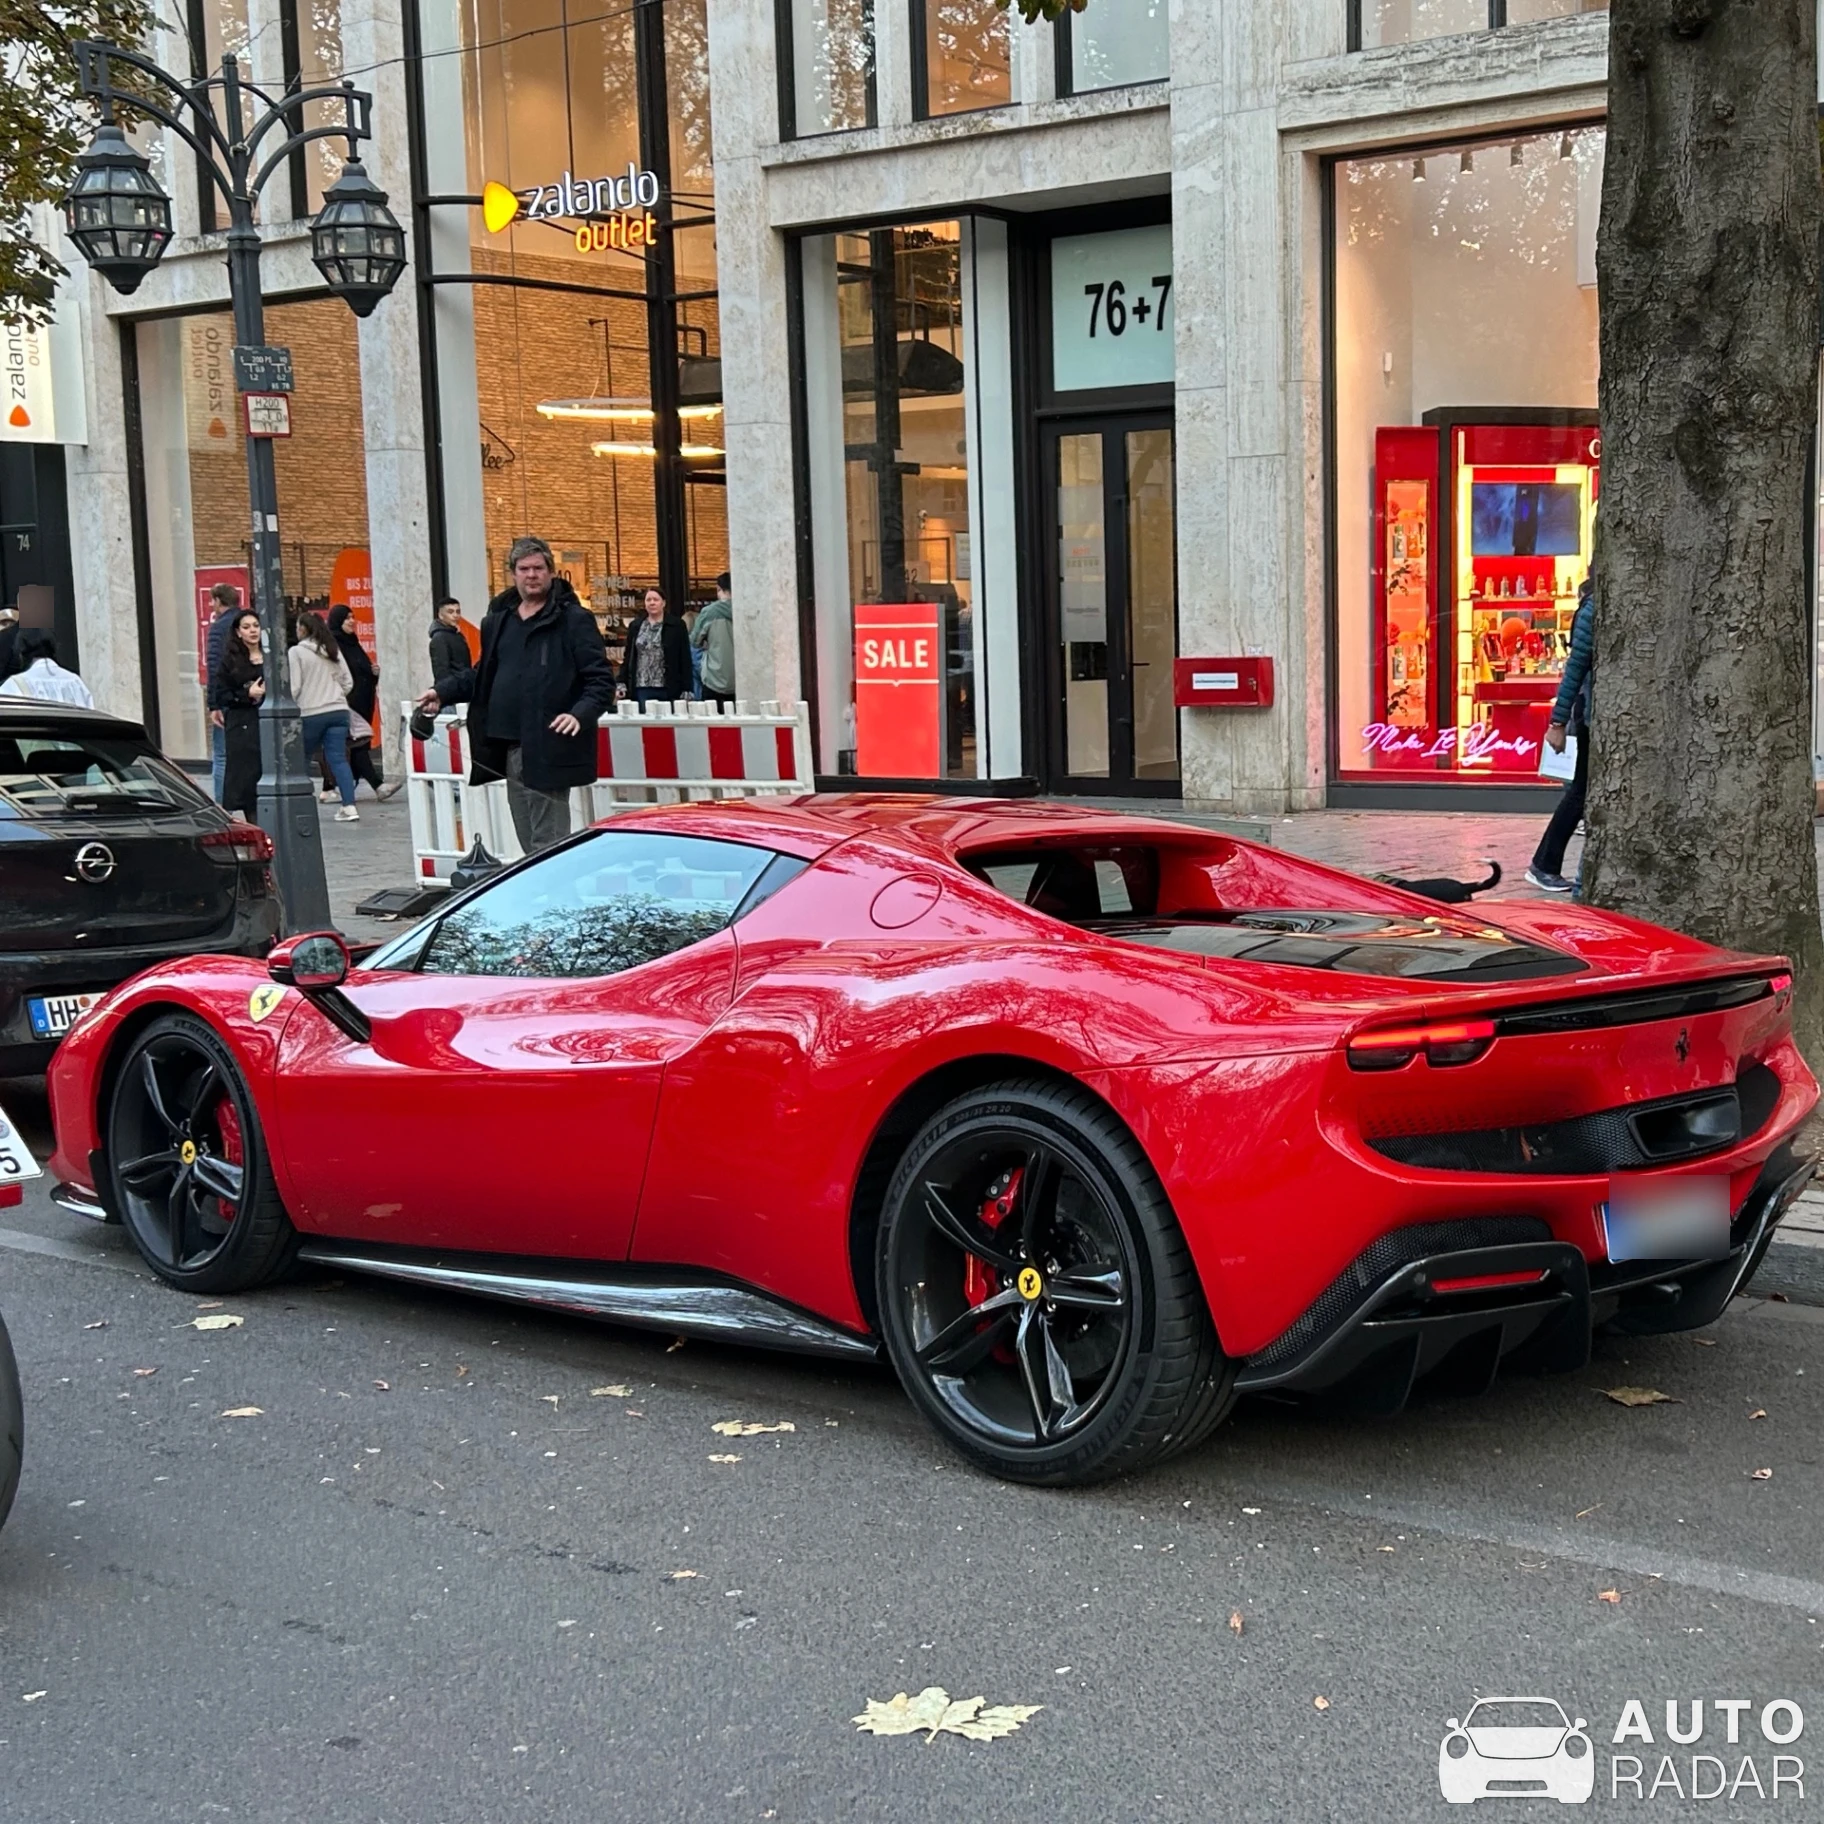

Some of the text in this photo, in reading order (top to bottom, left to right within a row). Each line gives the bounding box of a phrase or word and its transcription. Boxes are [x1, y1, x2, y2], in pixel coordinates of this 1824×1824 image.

[525, 162, 659, 221] zalando
[575, 212, 657, 254] outlet
[5, 323, 26, 400] zaland
[16, 534, 31, 551] 74
[863, 638, 930, 669] SALE
[1361, 721, 1538, 767] Make It Yours
